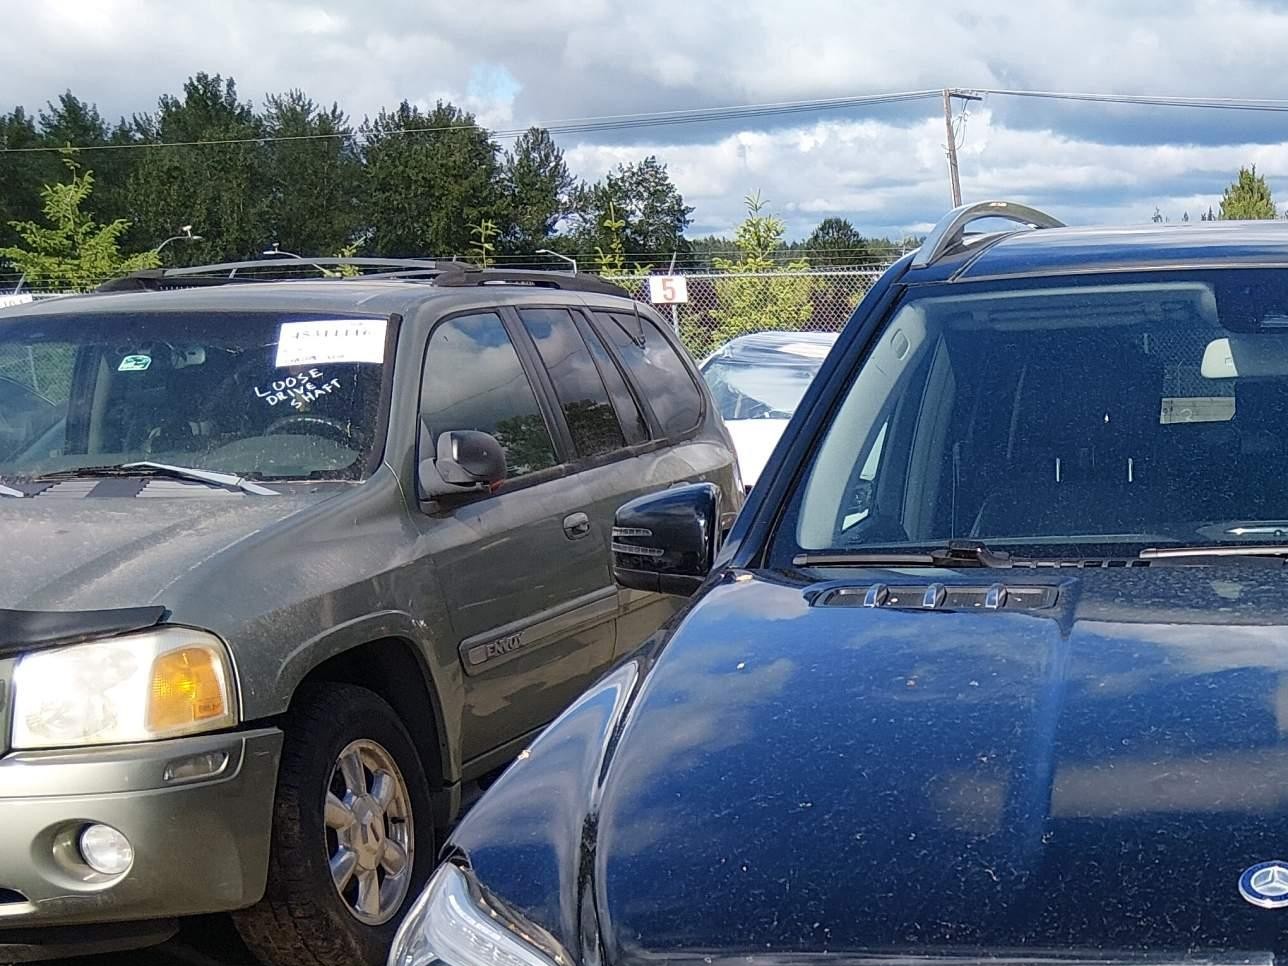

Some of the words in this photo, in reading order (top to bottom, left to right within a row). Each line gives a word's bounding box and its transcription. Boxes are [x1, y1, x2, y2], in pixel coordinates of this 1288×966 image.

[661, 277, 676, 301] 5
[254, 367, 324, 398] LOOSE
[265, 381, 318, 407] DRIVE
[290, 378, 342, 410] SHAFT
